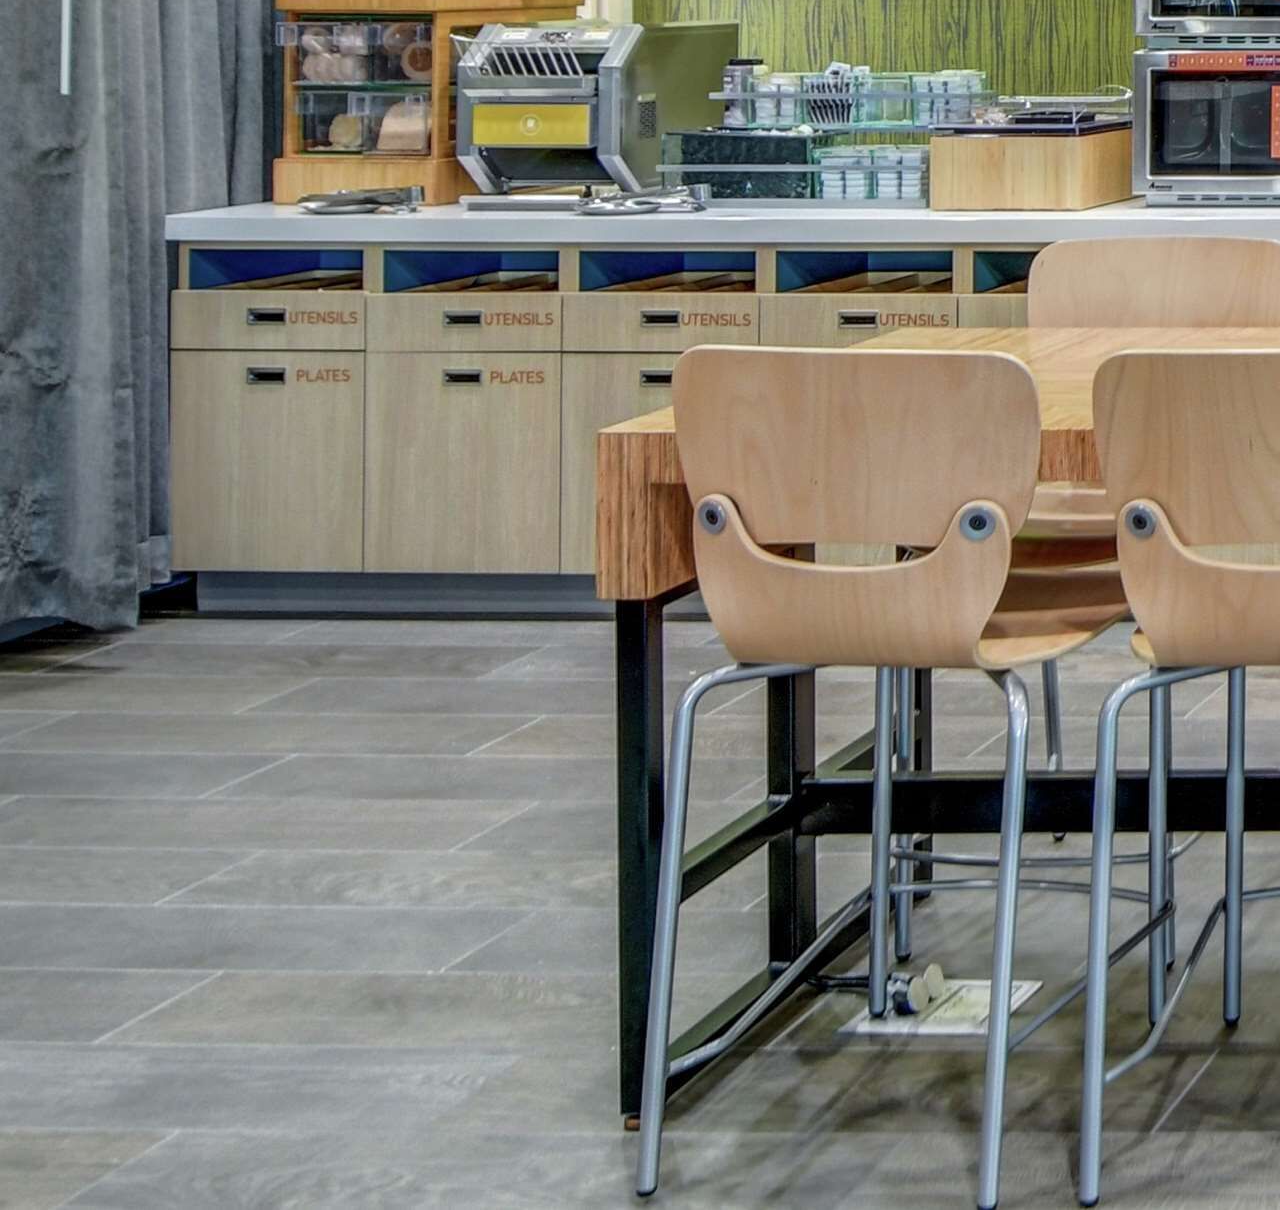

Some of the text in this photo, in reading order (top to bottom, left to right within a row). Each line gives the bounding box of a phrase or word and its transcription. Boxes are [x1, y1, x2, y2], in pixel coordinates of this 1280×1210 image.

[288, 310, 358, 325] UTENSILS
[484, 312, 554, 326] UTENSILS
[681, 312, 752, 327] UTENSILS
[880, 313, 950, 327] UTENSILS
[296, 369, 351, 383] PLATES
[489, 370, 545, 384] PLATES
